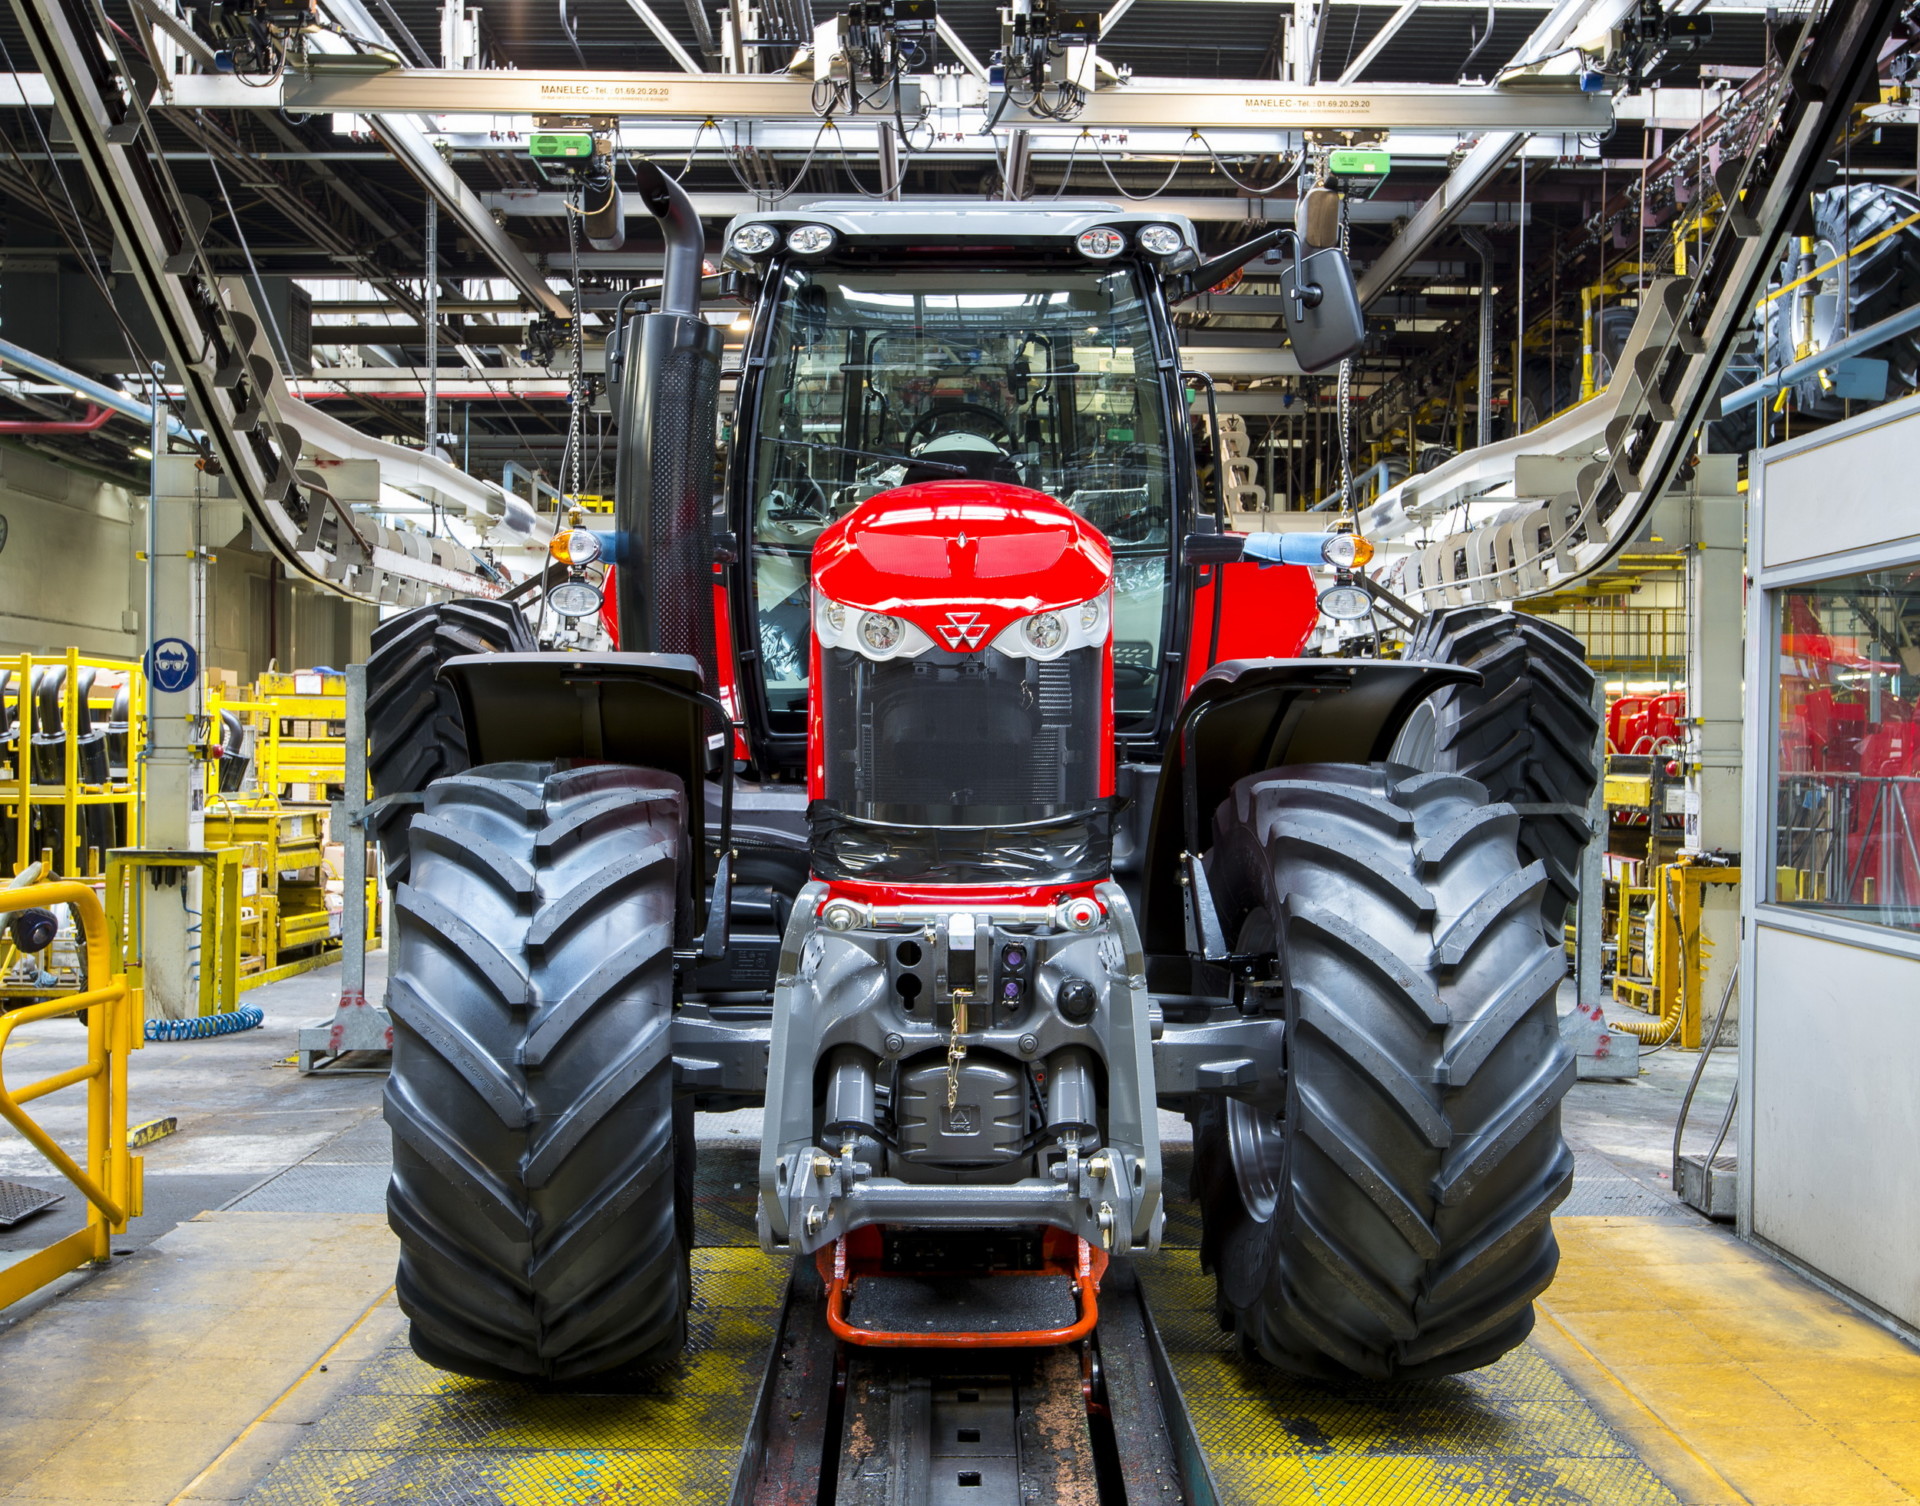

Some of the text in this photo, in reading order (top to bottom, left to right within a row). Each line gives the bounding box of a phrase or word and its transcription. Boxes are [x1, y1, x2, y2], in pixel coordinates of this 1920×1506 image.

[541, 85, 589, 95] MANELEC
[614, 87, 669, 96] 01.69.20.29.20
[1245, 98, 1292, 107] MANELEC
[1317, 100, 1370, 108] 01.69.20.29.20
